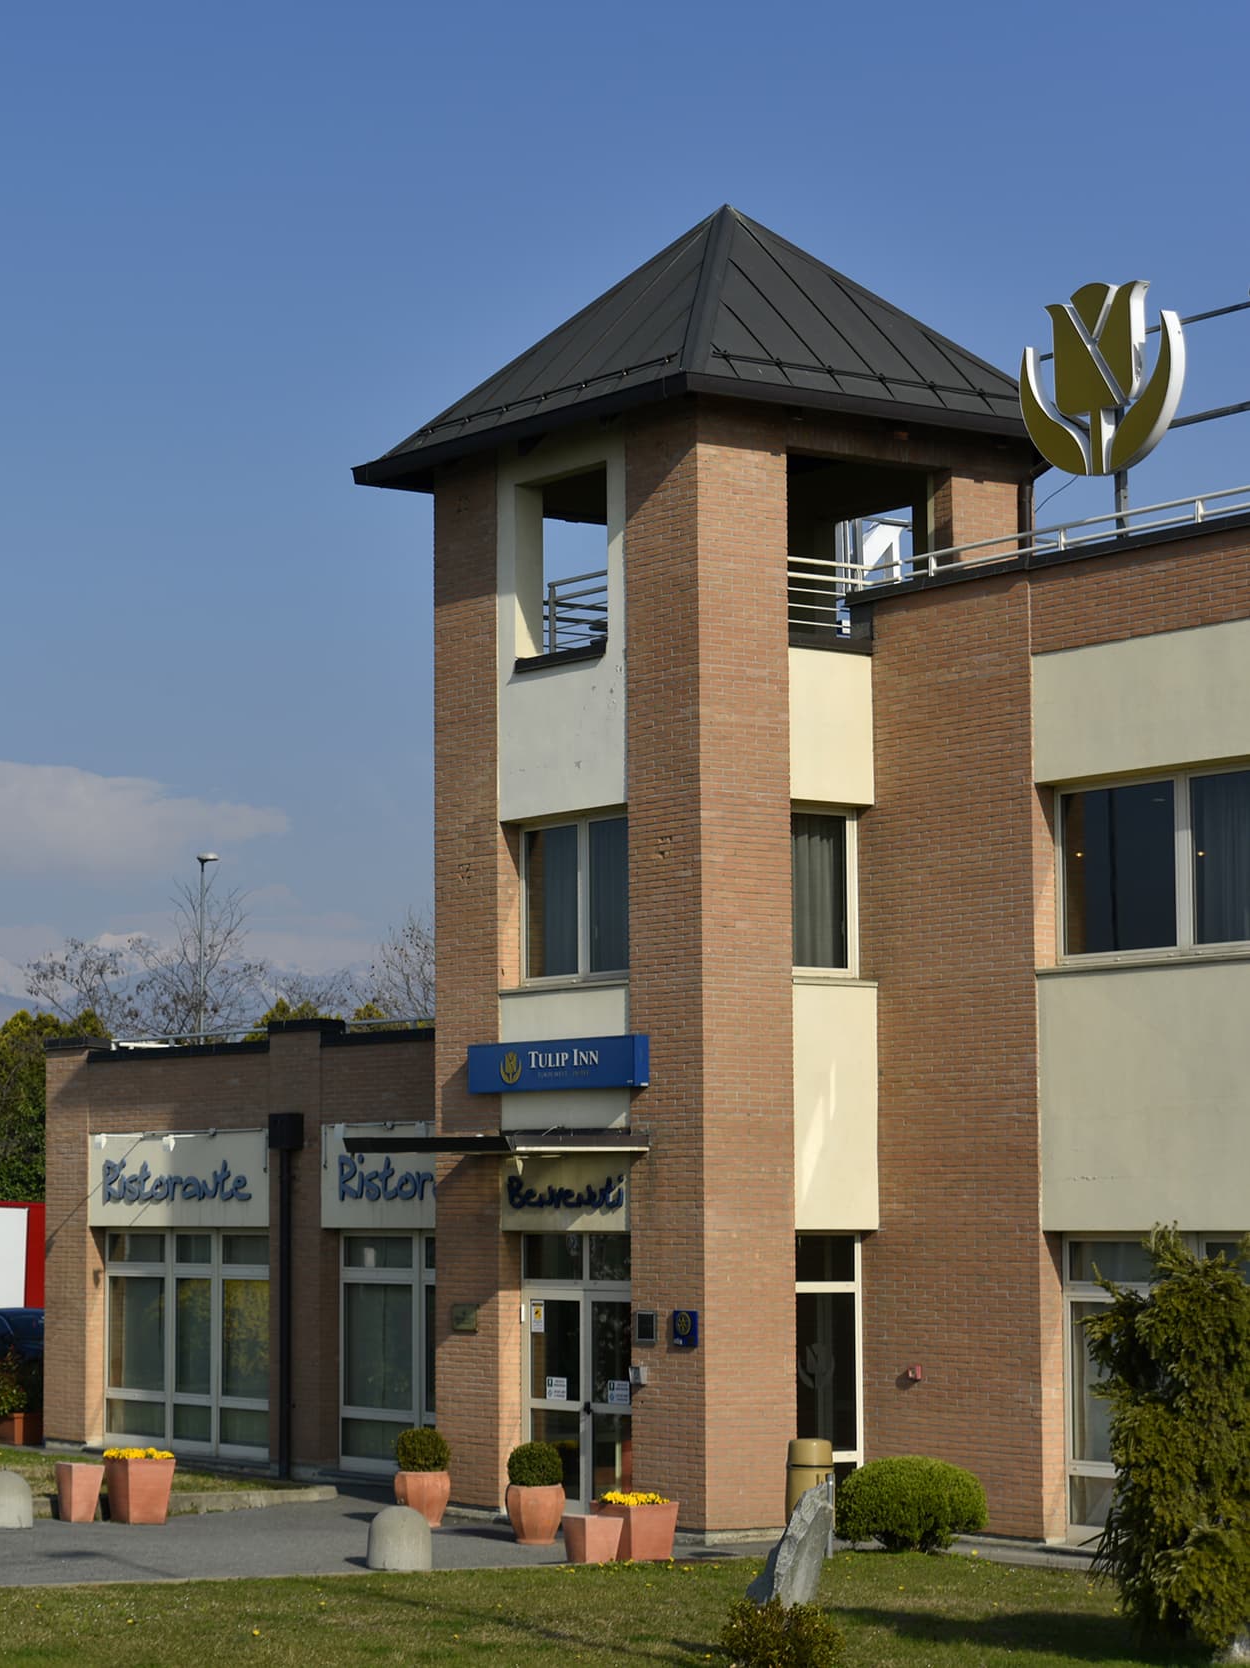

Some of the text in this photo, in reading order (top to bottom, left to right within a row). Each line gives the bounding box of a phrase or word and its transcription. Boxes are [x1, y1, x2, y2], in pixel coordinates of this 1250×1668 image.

[528, 1048, 599, 1068] TULIP INN
[103, 1160, 251, 1203] Ristorante
[338, 1154, 436, 1202] Ristor
[508, 1175, 624, 1209] Benvenuti
